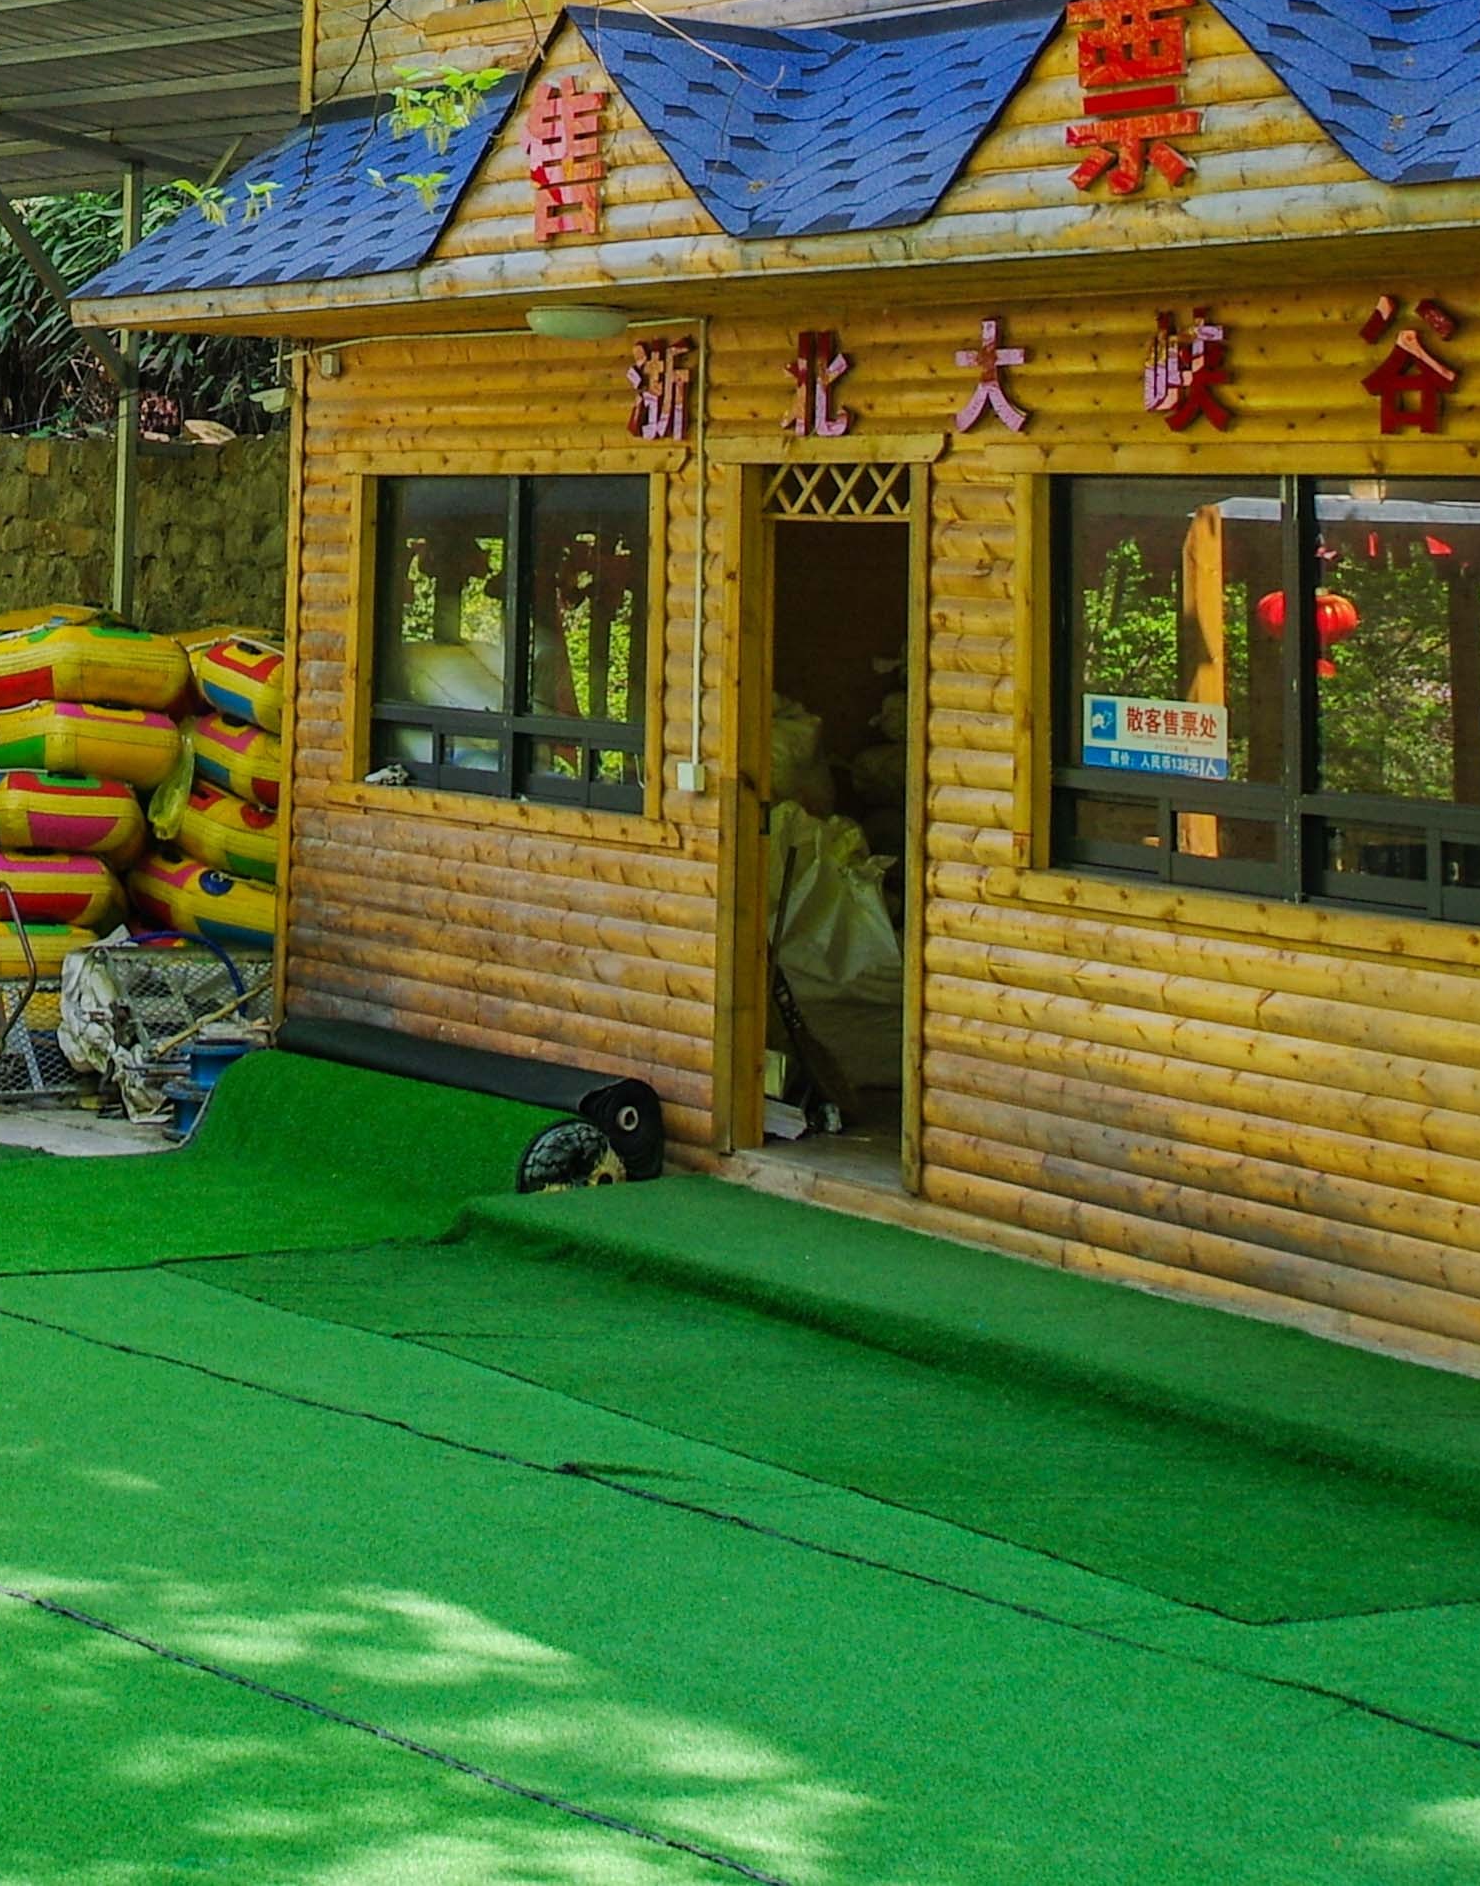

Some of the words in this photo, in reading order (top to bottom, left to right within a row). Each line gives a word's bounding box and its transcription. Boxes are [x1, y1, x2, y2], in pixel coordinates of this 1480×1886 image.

[1127, 705, 1218, 739] 散客售票处
